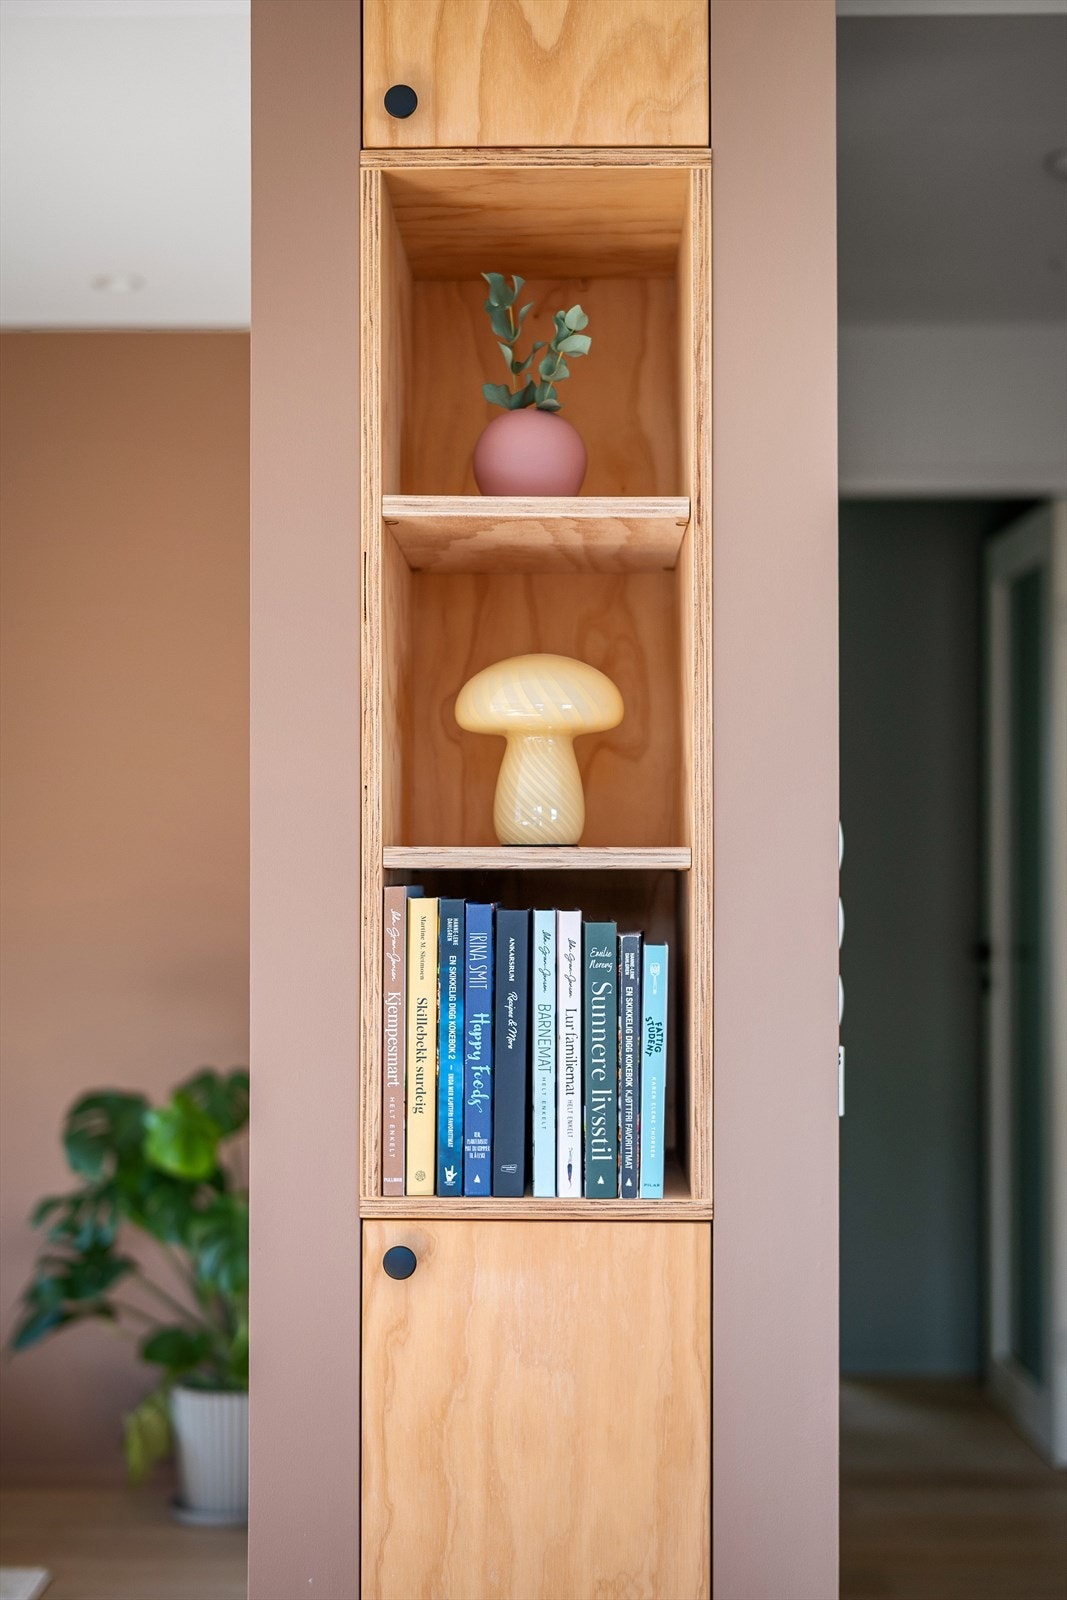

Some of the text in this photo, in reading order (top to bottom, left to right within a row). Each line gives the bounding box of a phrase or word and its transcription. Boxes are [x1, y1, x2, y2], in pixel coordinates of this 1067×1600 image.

[448, 966, 457, 1001] SKIKKELIG
[449, 955, 457, 965] EN
[469, 932, 488, 990] IRINA SMIT
[385, 991, 402, 1088] Kjempesmart
[448, 1003, 457, 1019] DIGG
[448, 1021, 457, 1053] KOKEBOK
[505, 991, 518, 1049] Recipes & More
[537, 1003, 552, 1074] BARNEMAT
[565, 1008, 577, 1030] Lur
[644, 1016, 656, 1057] STUDENT
[654, 1021, 663, 1053] FATTIG
[412, 997, 428, 1114] Skillebekk surdeig
[465, 1012, 491, 1113] Happy Foods
[565, 1032, 578, 1096] familiemat
[591, 981, 613, 1161] Sunnere livsstil
[624, 986, 633, 1170] EN SKIKKELIG DIGG KOKEBOK KJØTTFRI FAVORITTMAT
